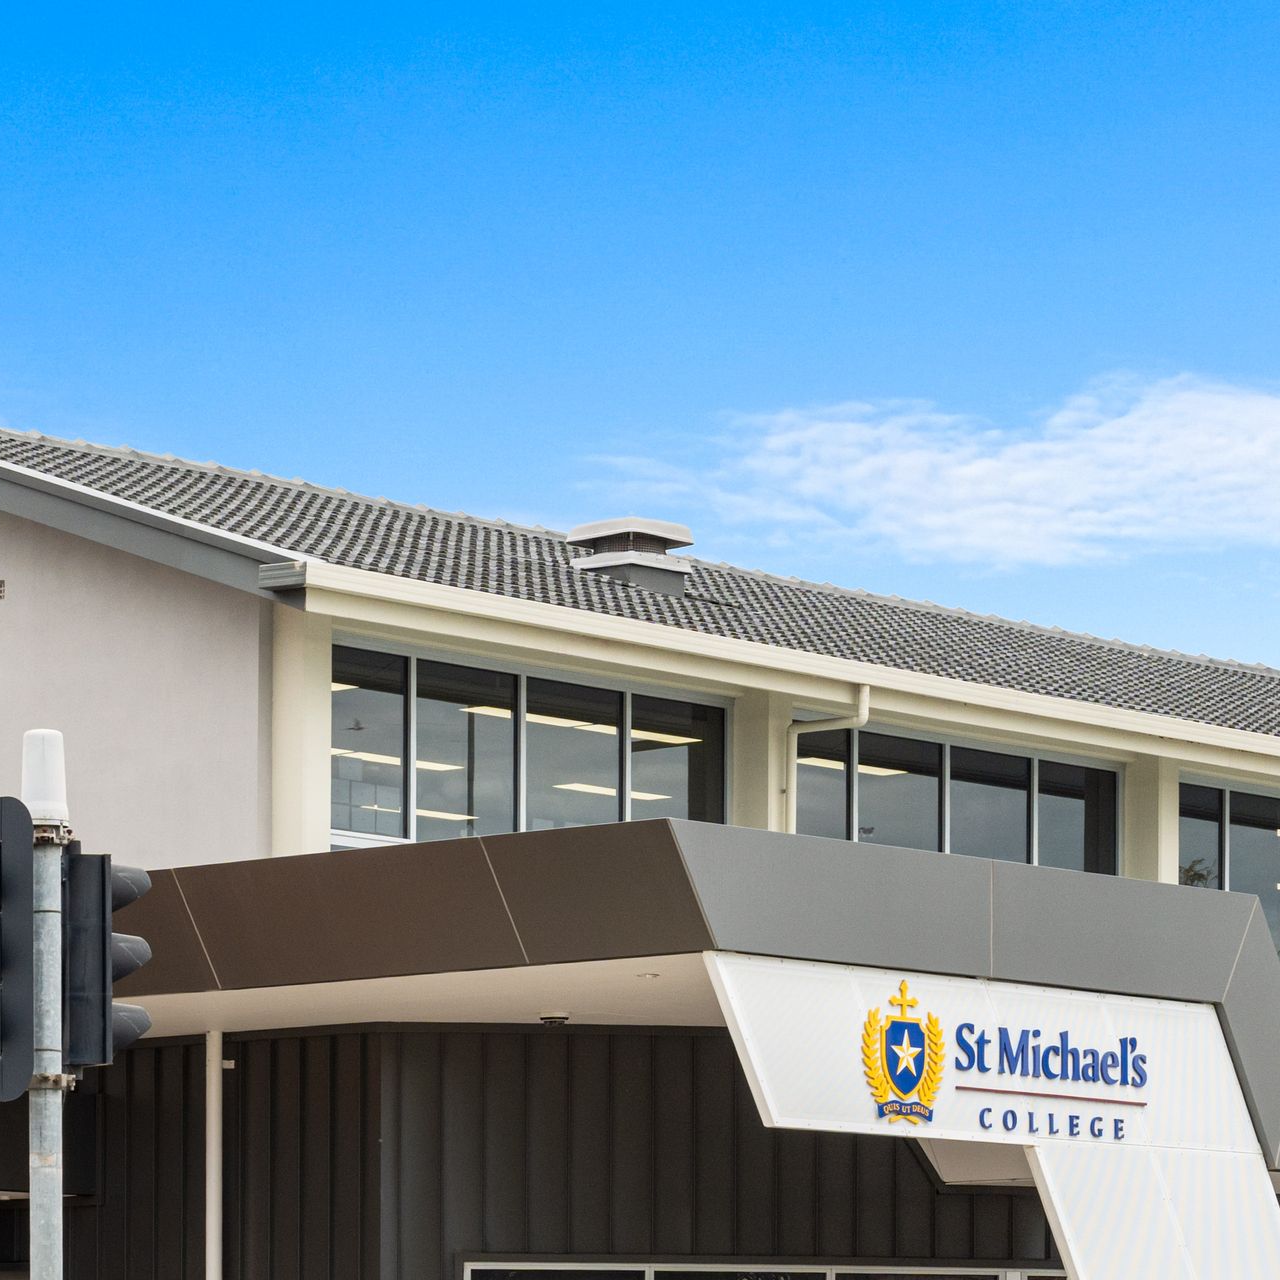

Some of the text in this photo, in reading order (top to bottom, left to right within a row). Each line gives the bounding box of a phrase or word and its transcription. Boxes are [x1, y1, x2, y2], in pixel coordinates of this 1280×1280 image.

[954, 1022, 1148, 1089] St Michael's
[883, 1103, 929, 1117] QUIS UT DEUS
[978, 1107, 1126, 1140] COLLEGE
